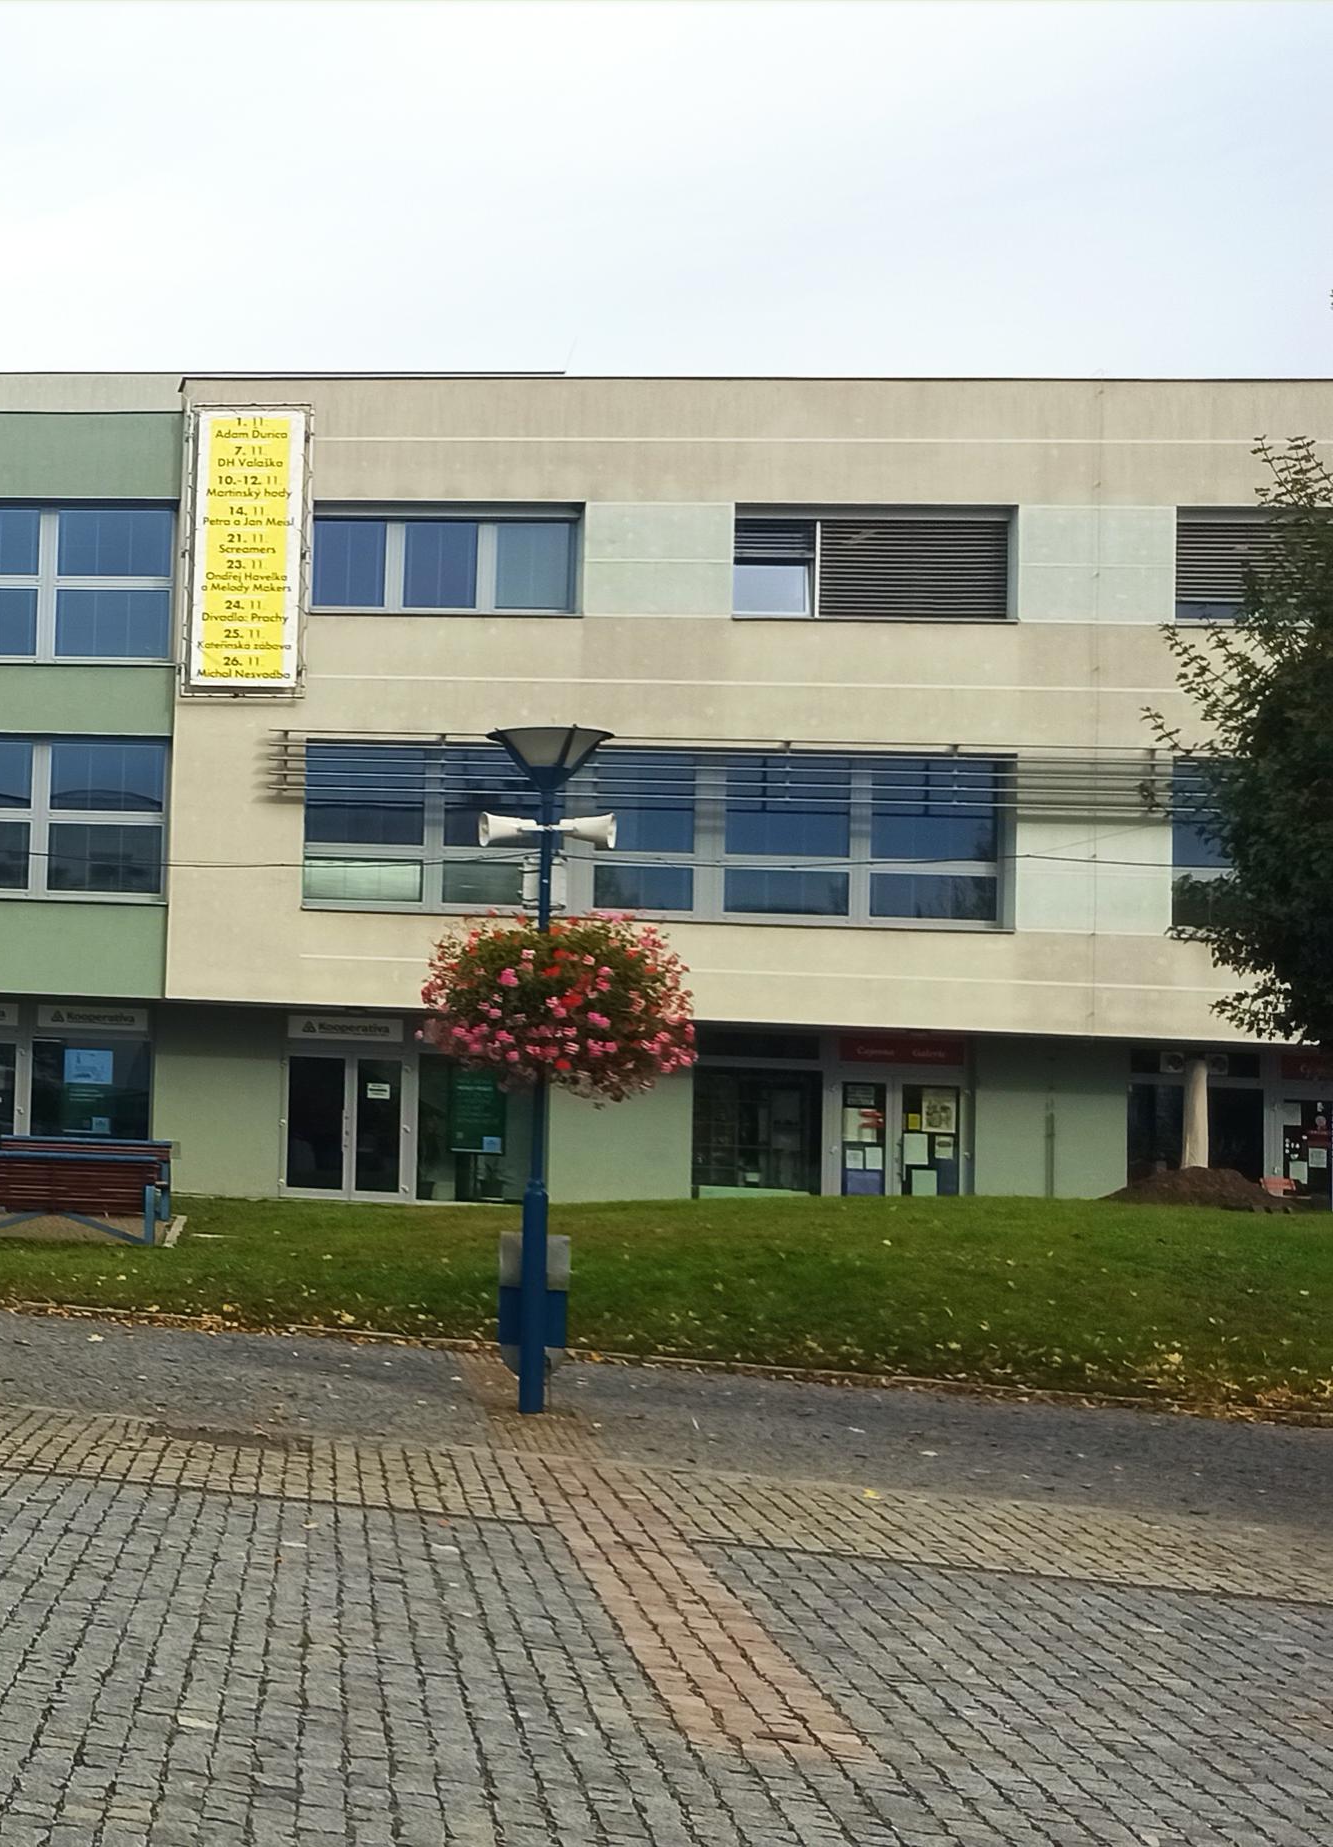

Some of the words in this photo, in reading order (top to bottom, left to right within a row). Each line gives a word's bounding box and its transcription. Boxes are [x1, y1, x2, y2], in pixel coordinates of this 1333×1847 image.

[237, 417, 248, 426] 1.
[215, 430, 249, 439] Adam
[252, 426, 288, 439] Ďurica
[235, 446, 247, 456] 7.
[218, 458, 235, 468] DH
[238, 458, 284, 468] Valaška
[218, 476, 262, 485] 10.-12.
[264, 488, 293, 499] hody
[229, 506, 248, 516] 14.
[203, 517, 231, 526] Petra
[243, 518, 263, 526] Jan
[227, 534, 248, 543] 21.
[219, 544, 277, 554] Screamers
[227, 560, 247, 570] 23.
[206, 572, 242, 583] Ondřej
[244, 572, 288, 581] Havelka
[211, 583, 250, 594] Melody
[253, 583, 292, 592] Makers
[225, 600, 245, 610] 24.
[251, 613, 289, 624] Prachy
[224, 629, 244, 639] 25.
[223, 657, 243, 667] 26.
[197, 669, 232, 679] Michal
[235, 669, 291, 679] Nesvadba
[66, 1011, 135, 1024] Kooperativa
[318, 1021, 390, 1035] Kooperativa
